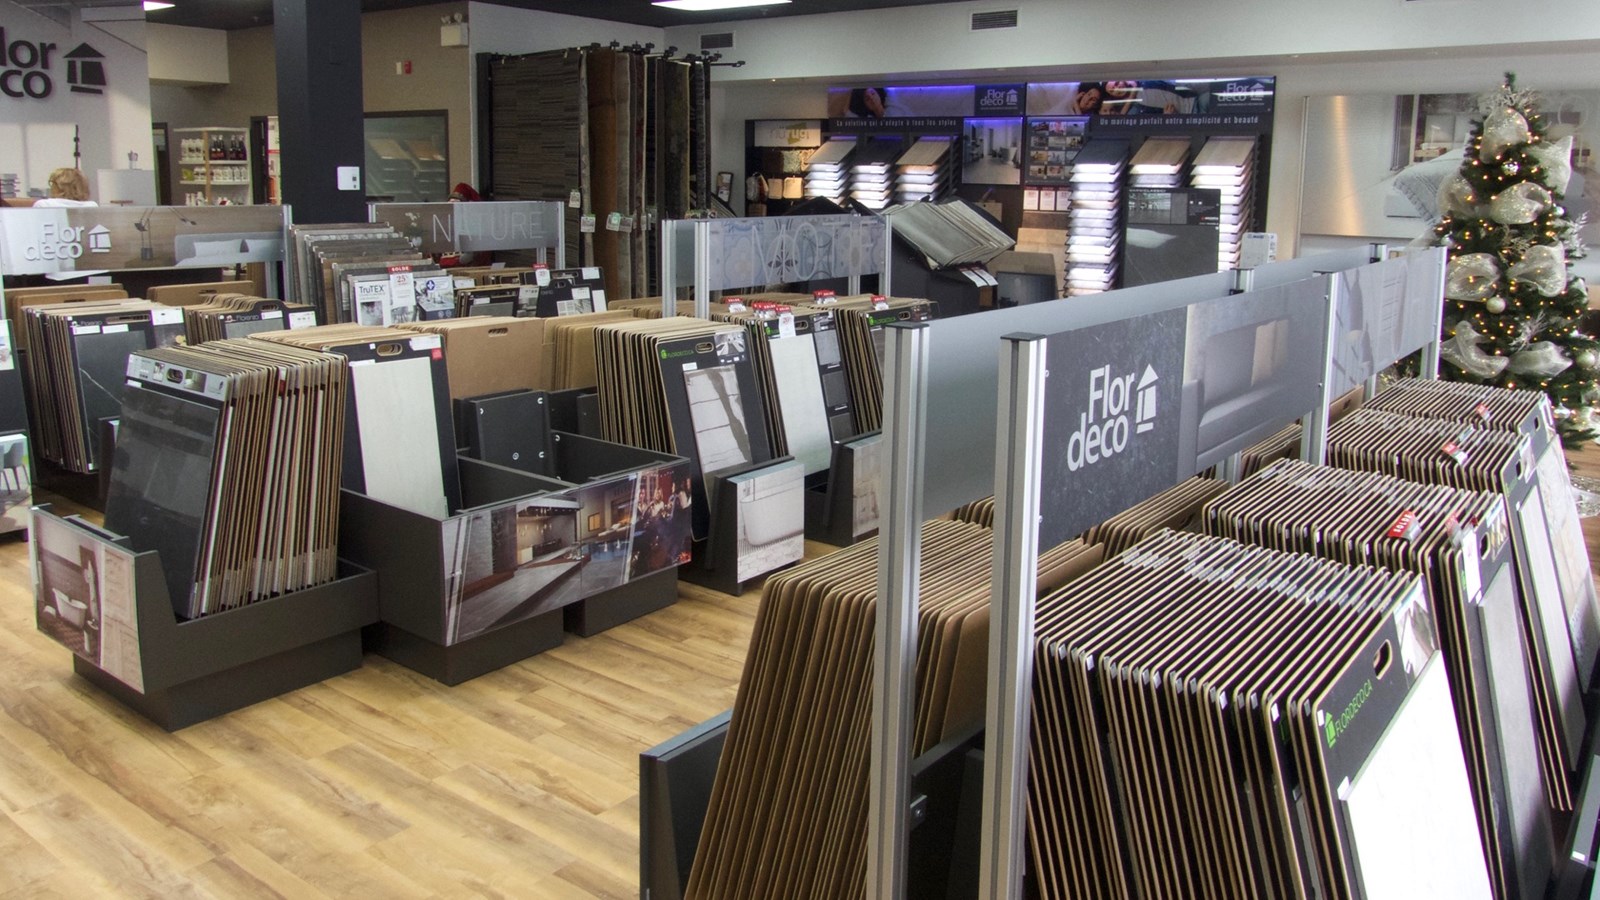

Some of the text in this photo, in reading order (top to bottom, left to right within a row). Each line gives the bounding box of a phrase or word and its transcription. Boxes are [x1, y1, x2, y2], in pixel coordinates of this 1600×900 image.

[0, 27, 56, 69] lor
[0, 69, 52, 98] co
[1226, 82, 1249, 94] Flor
[980, 96, 1004, 106] deco
[987, 89, 1005, 99] Flor
[845, 119, 867, 127] solution
[1110, 118, 1137, 127] mariage
[1139, 117, 1163, 127] parfait
[1165, 117, 1183, 125] entre
[1185, 116, 1221, 126] simplicité
[1234, 116, 1259, 124] beauté
[42, 223, 85, 243] Flor
[433, 211, 544, 243] NATURE
[24, 238, 83, 260] deco
[1088, 364, 1135, 424] Flor
[1067, 412, 1129, 472] deco
[1393, 513, 1412, 533] SOLDE
